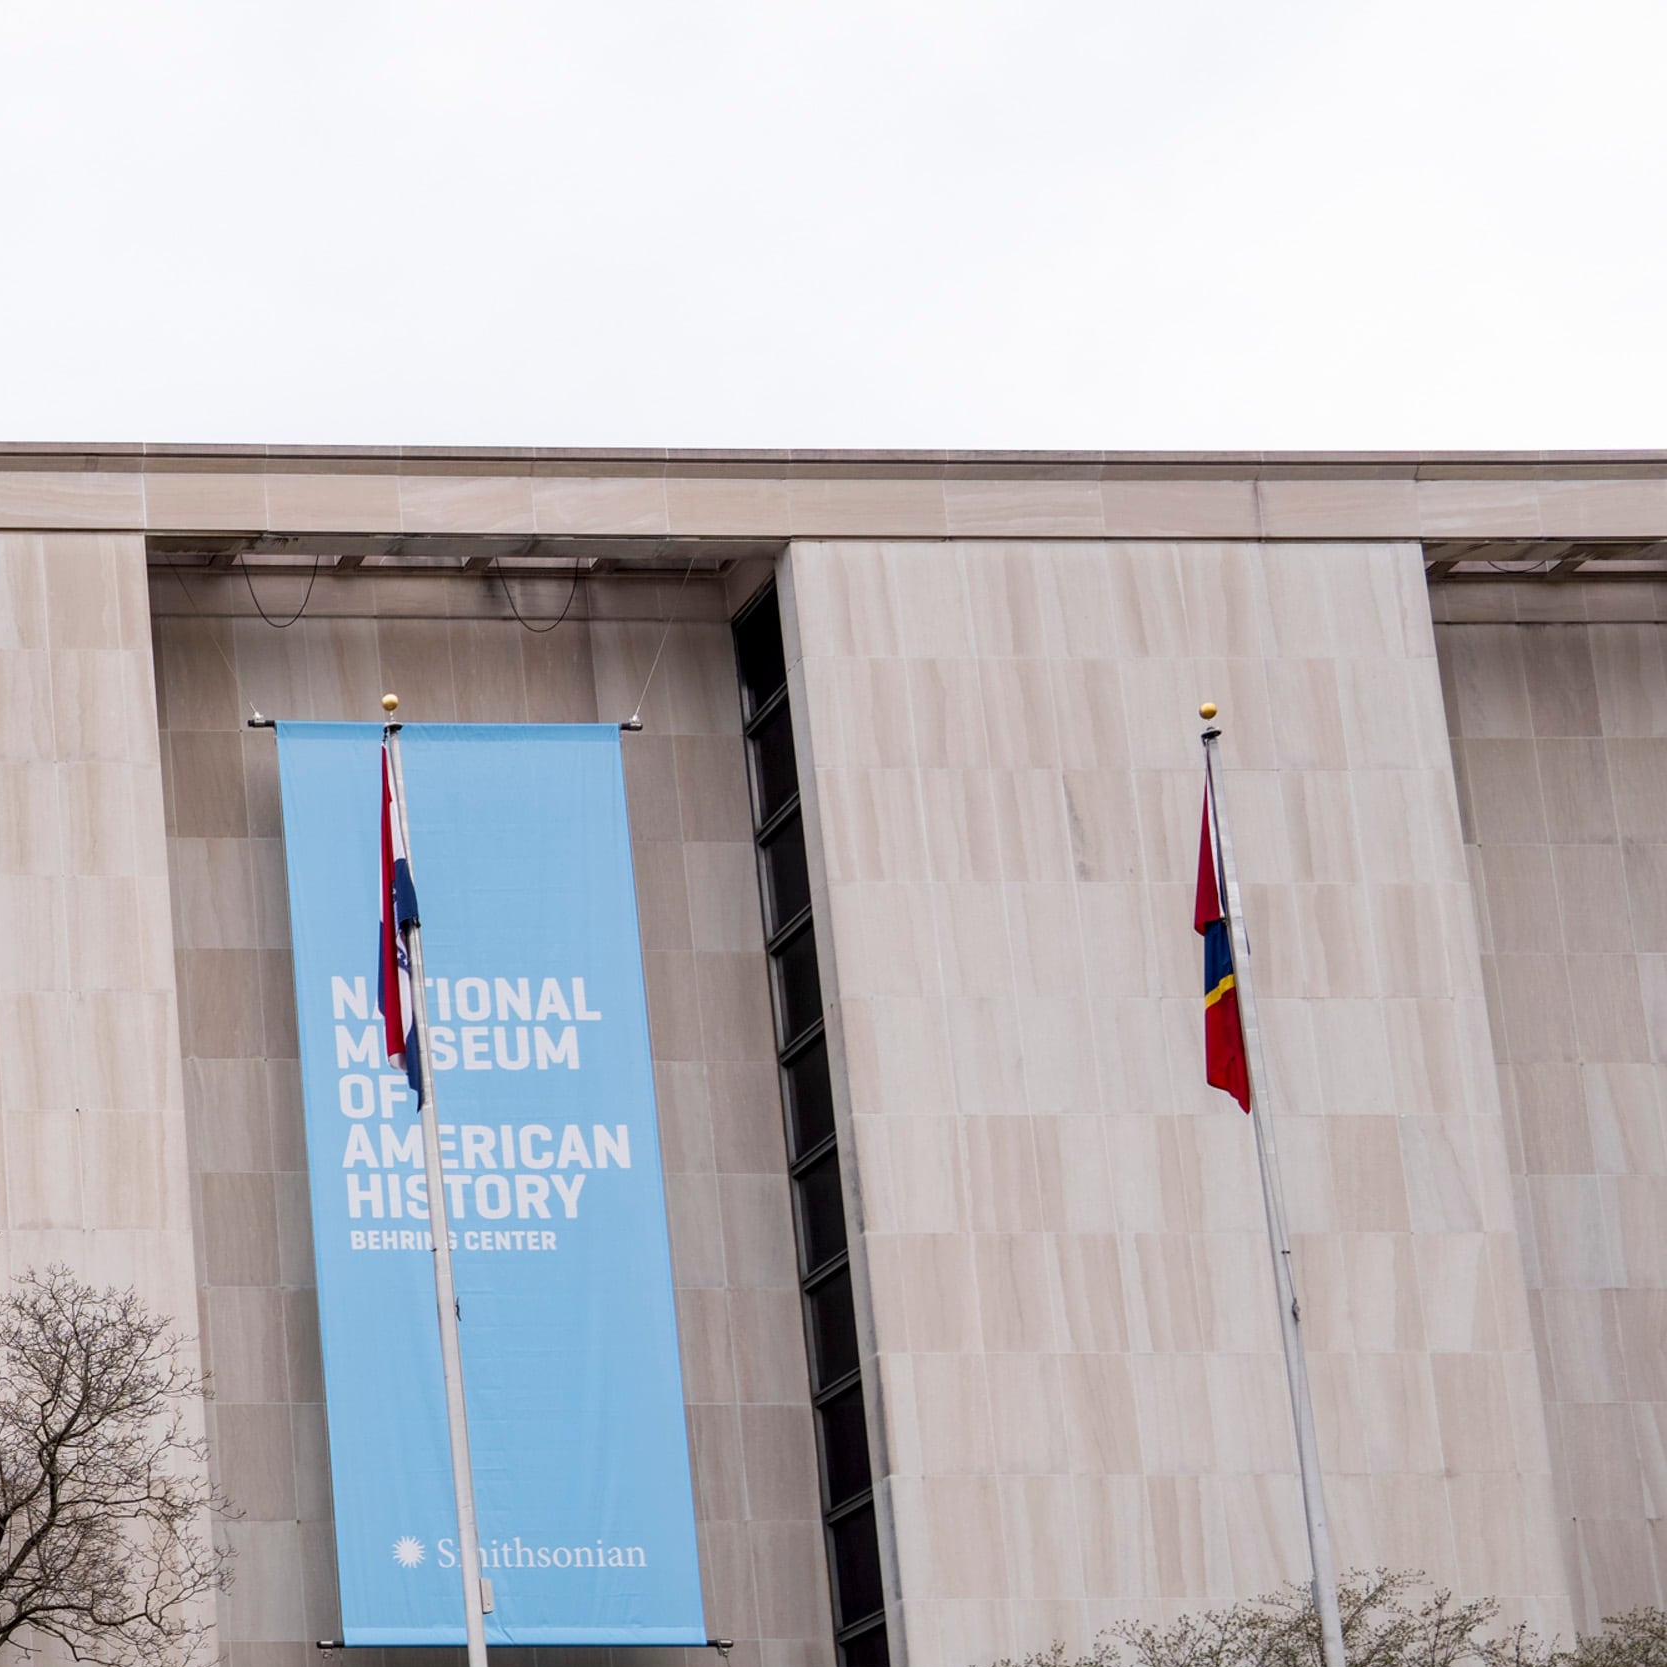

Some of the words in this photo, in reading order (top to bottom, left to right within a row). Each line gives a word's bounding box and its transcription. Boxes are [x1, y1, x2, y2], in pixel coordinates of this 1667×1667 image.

[331, 976, 602, 1021] NIONAL
[335, 1025, 580, 1070] MSEUM
[338, 1074, 409, 1119] OF
[342, 1124, 632, 1169] AMERICAN
[346, 1174, 587, 1219] HISTORY
[464, 1231, 557, 1250] CENTER
